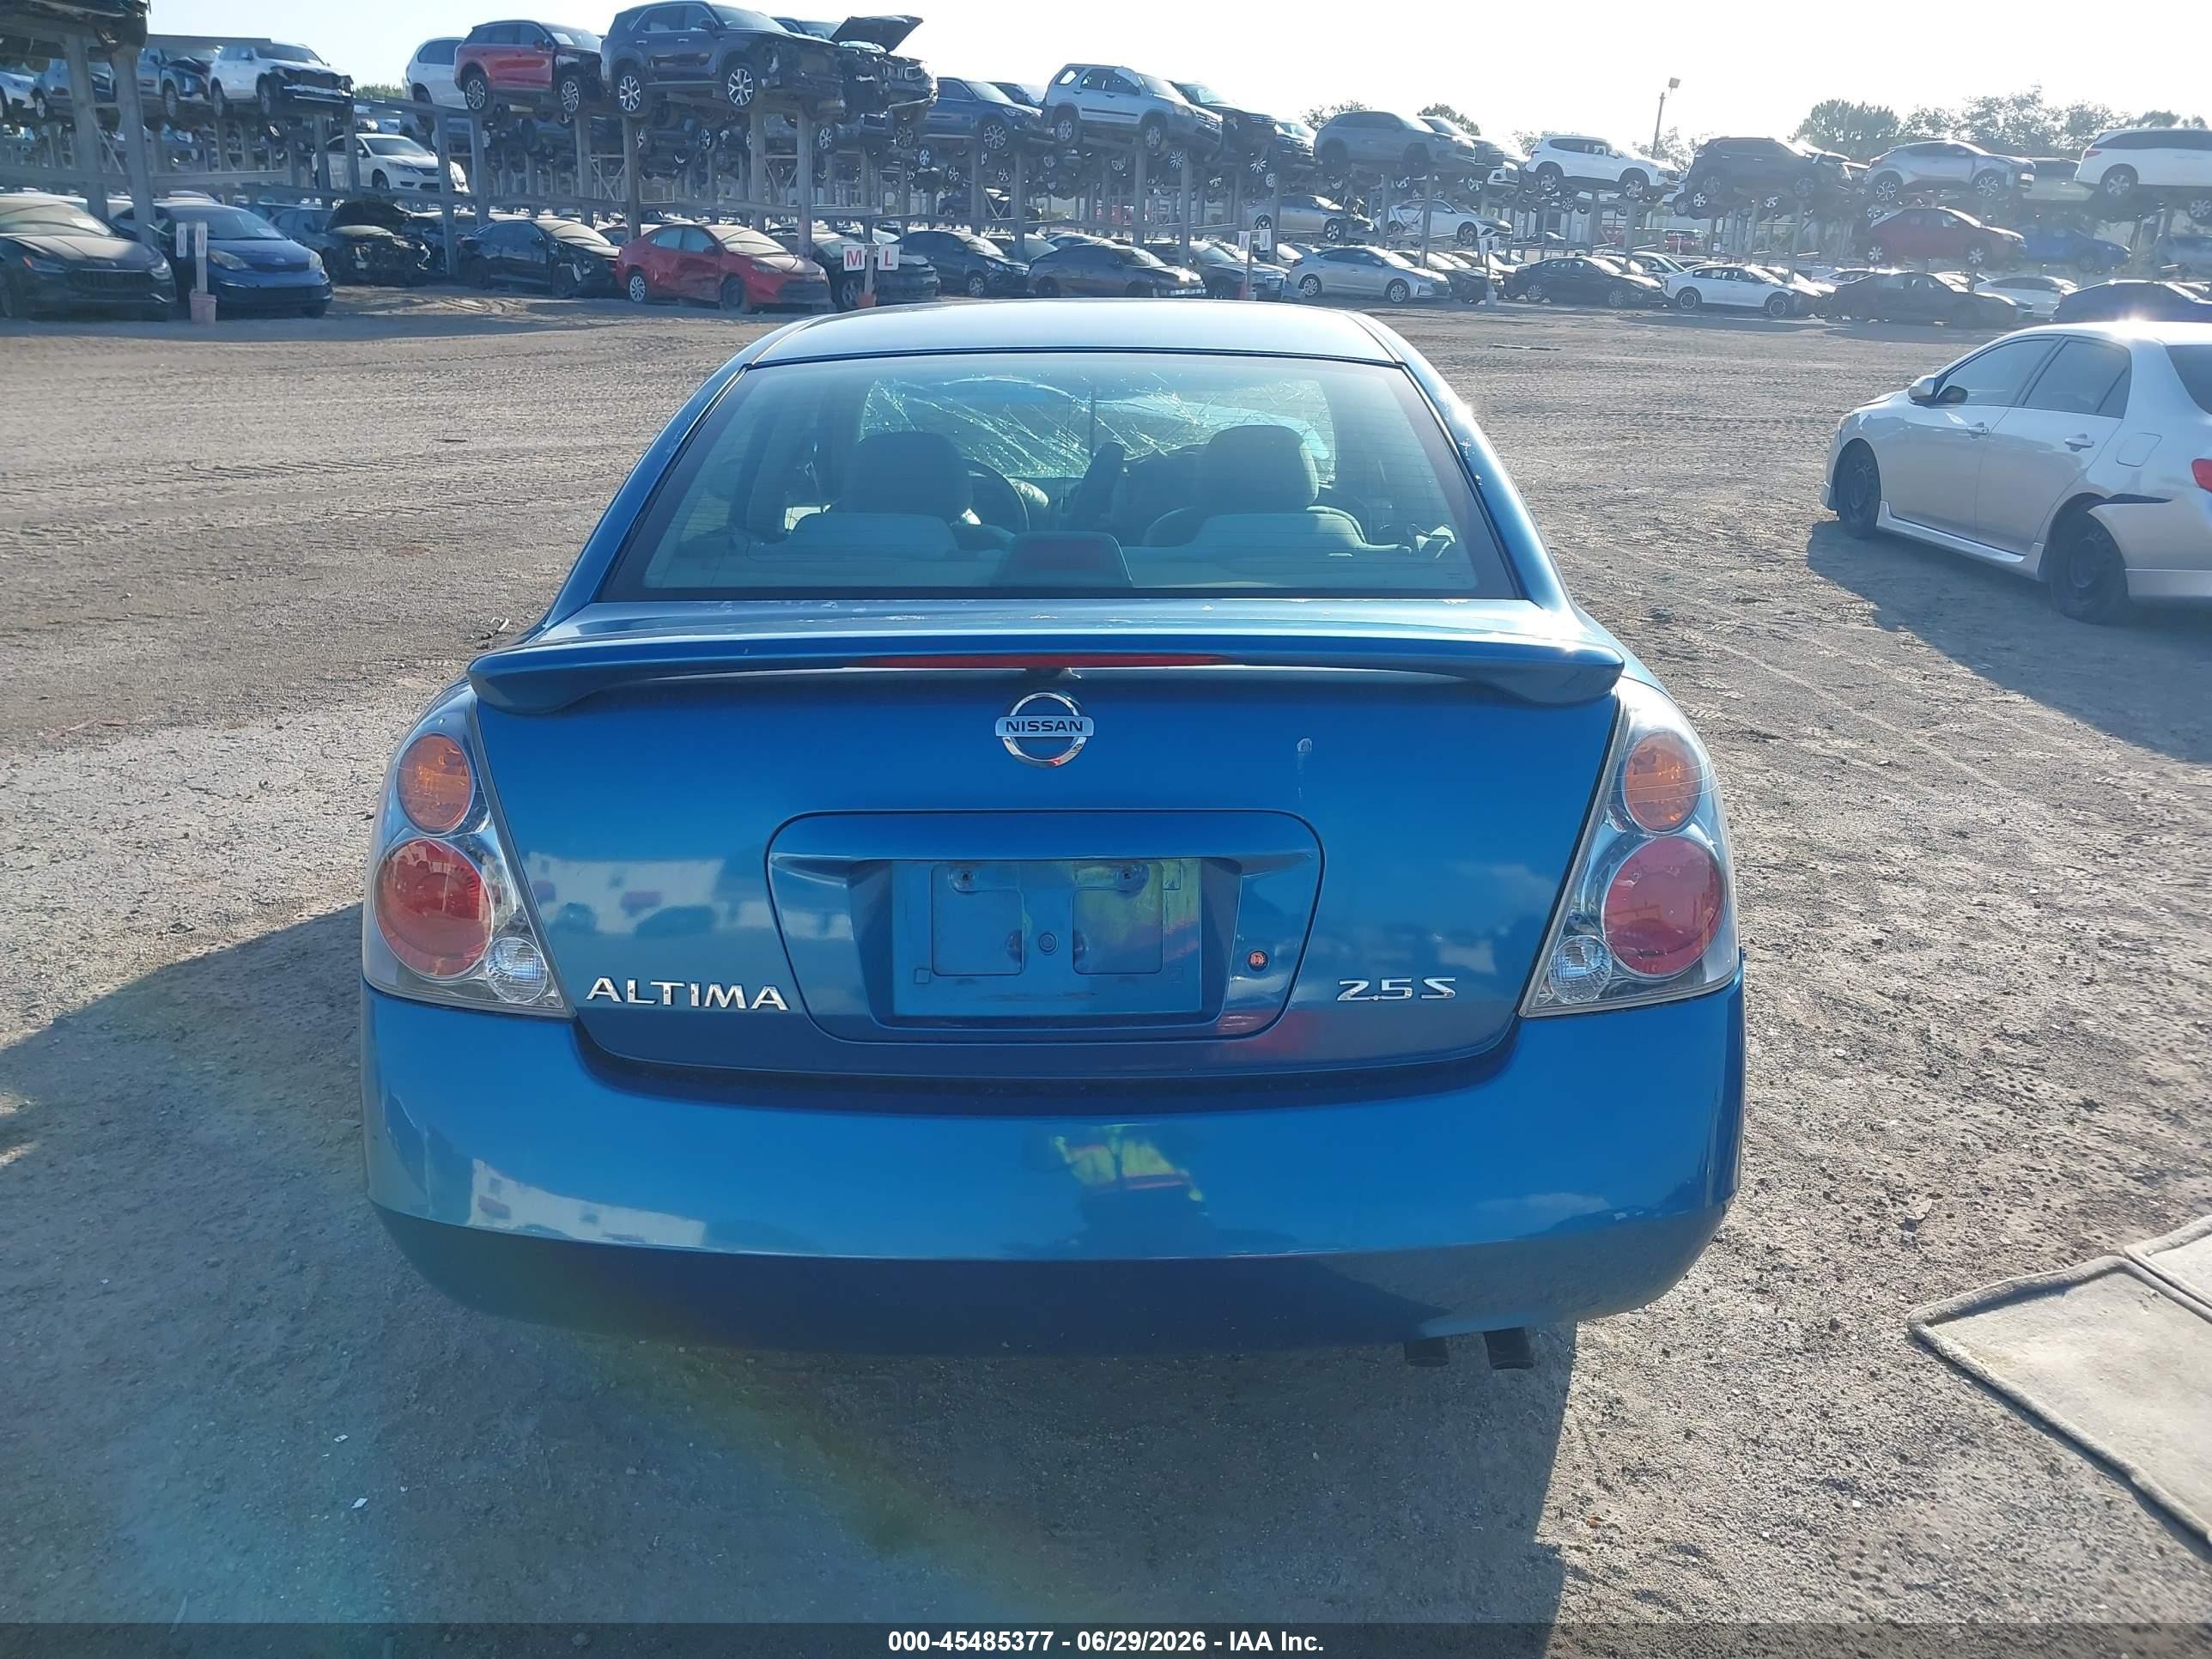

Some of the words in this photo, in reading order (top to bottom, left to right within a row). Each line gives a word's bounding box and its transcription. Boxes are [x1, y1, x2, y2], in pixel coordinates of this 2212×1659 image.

[846, 250, 862, 267] M
[884, 250, 894, 267] L
[1006, 720, 1084, 732] NISSAN
[586, 976, 790, 1012] ALTIMA
[1337, 977, 1413, 1001] 2.5
[1420, 976, 1457, 1000] S
